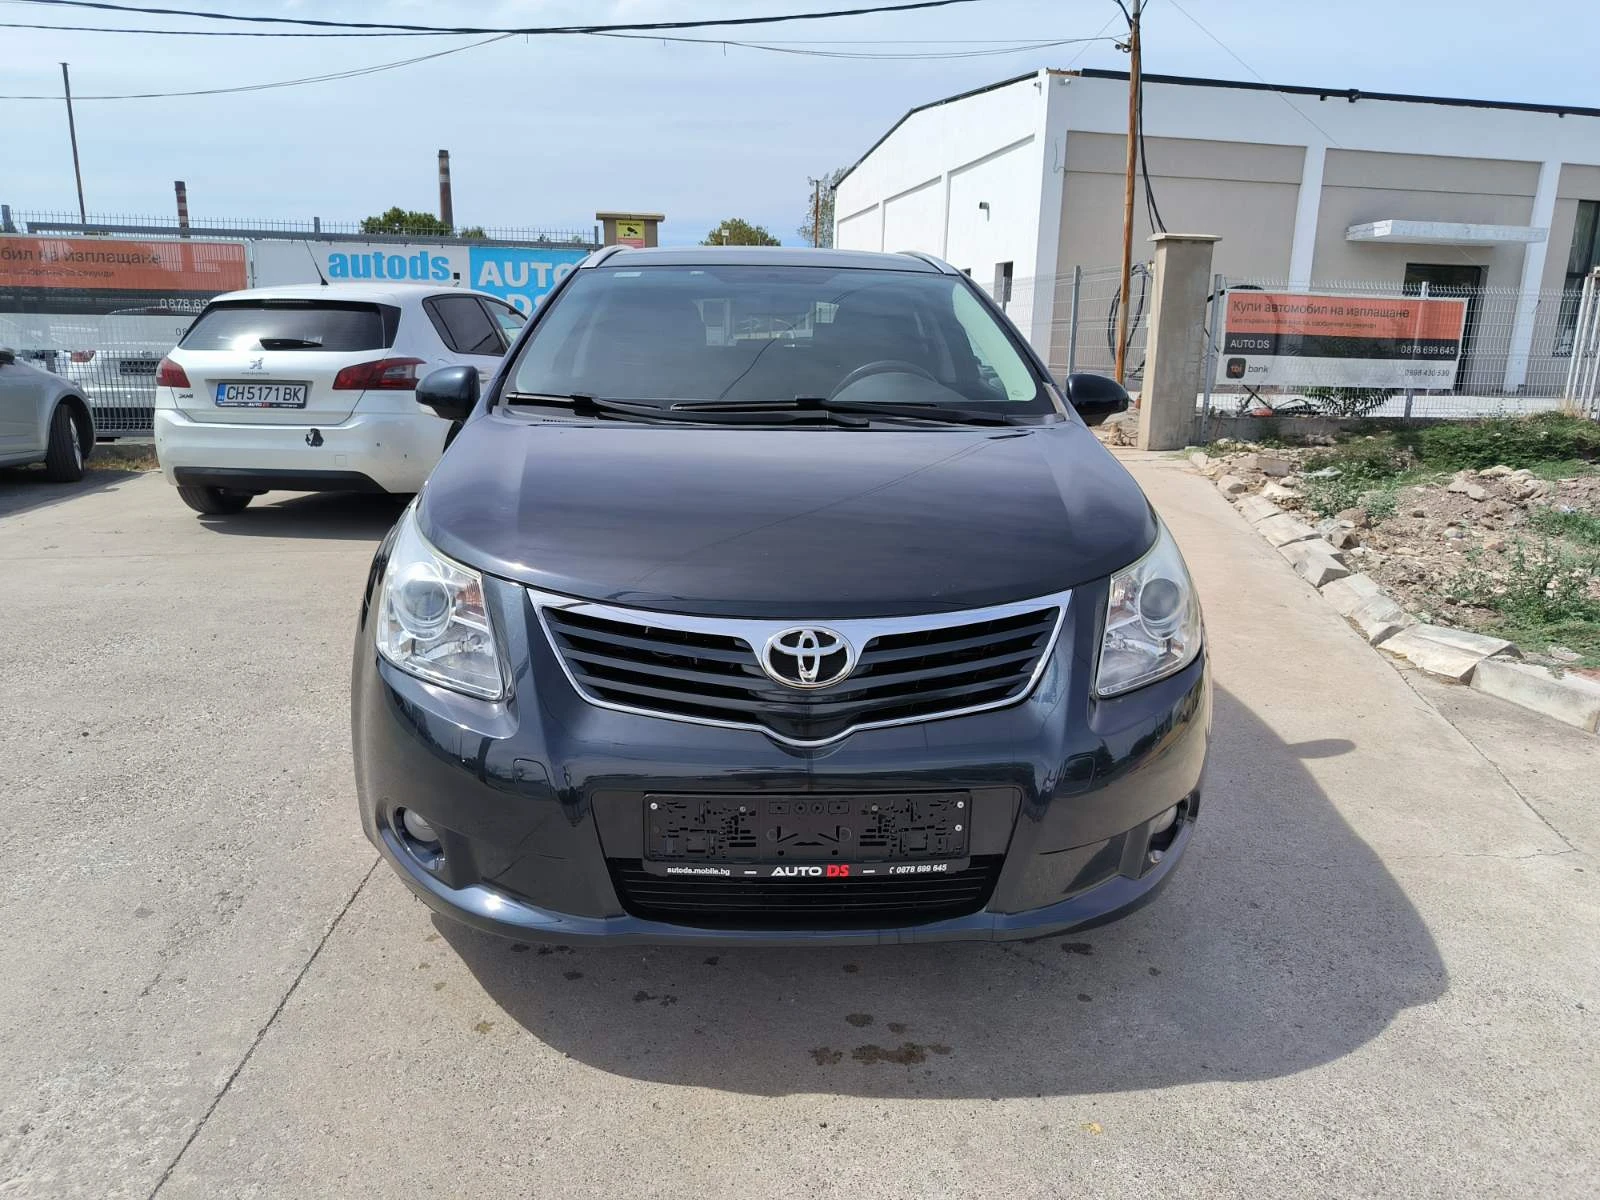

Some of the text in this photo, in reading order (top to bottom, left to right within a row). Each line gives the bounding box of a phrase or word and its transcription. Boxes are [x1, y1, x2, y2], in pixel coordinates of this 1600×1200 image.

[328, 250, 450, 281] autods
[1233, 300, 1262, 314] Купи
[1264, 302, 1328, 315] автомобил
[1330, 306, 1344, 316] на
[1230, 339, 1270, 349] AUTO DS
[771, 866, 822, 877] AUTO
[826, 864, 849, 877] DS
[896, 865, 915, 874] 0878
[932, 863, 947, 872] 645
